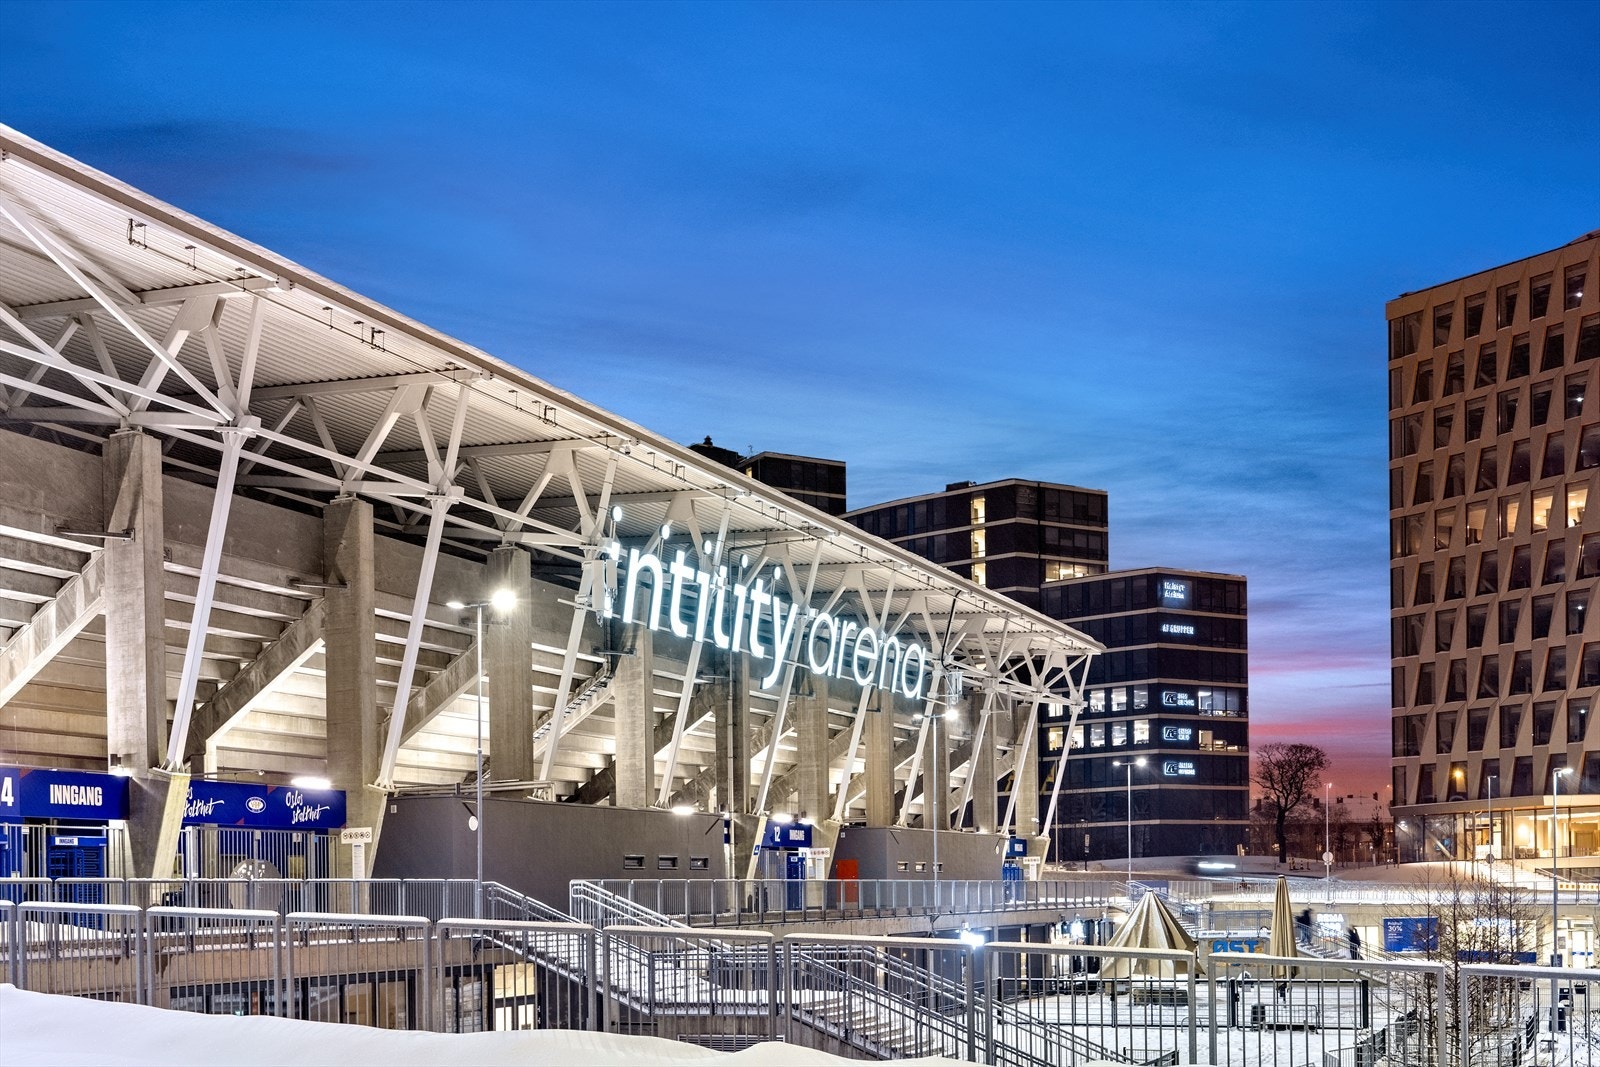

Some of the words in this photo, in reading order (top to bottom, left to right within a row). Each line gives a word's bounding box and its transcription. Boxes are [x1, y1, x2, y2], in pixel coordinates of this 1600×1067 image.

[603, 506, 798, 690] intility
[808, 612, 926, 700] arena
[0, 777, 14, 806] 4
[49, 784, 102, 806] INNGANG
[285, 790, 303, 809] Oslos
[183, 798, 225, 818] tolthet
[774, 826, 780, 842] 12
